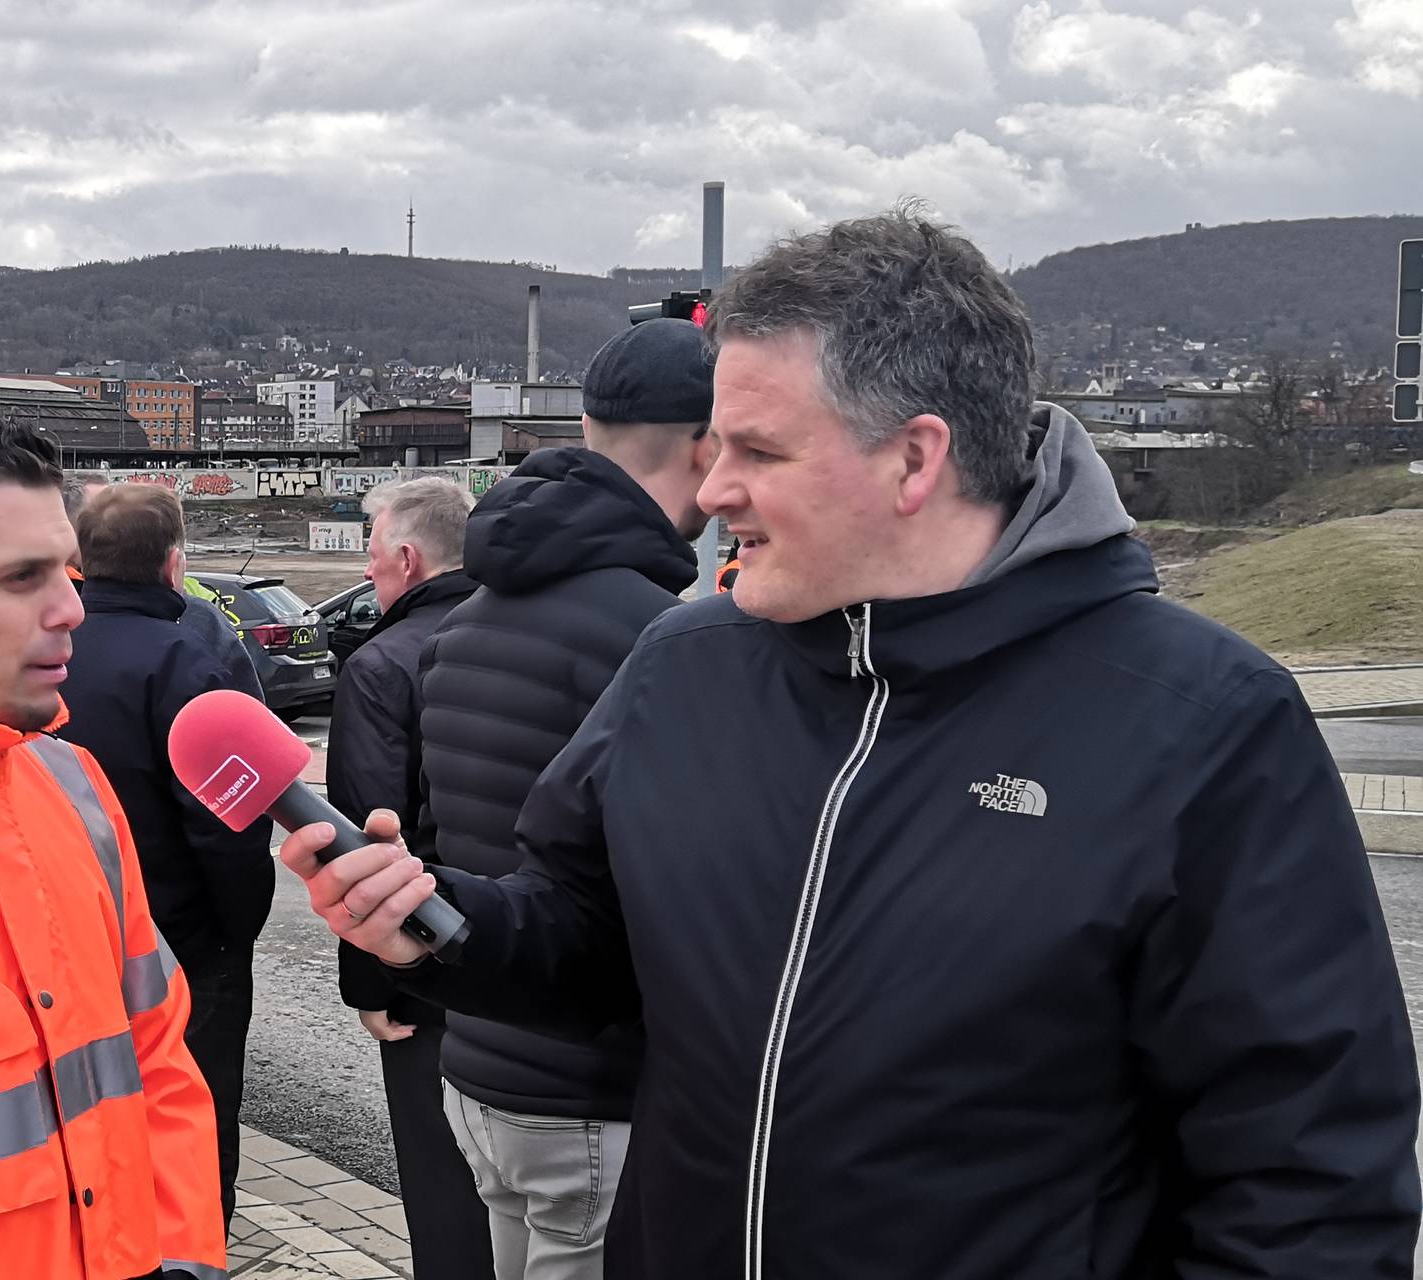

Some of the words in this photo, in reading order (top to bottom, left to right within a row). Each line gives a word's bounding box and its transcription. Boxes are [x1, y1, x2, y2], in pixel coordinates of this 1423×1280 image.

[215, 773, 250, 805] hagen
[996, 773, 1027, 790] THE
[968, 782, 1023, 801] NORTH
[979, 795, 1019, 813] FACE
